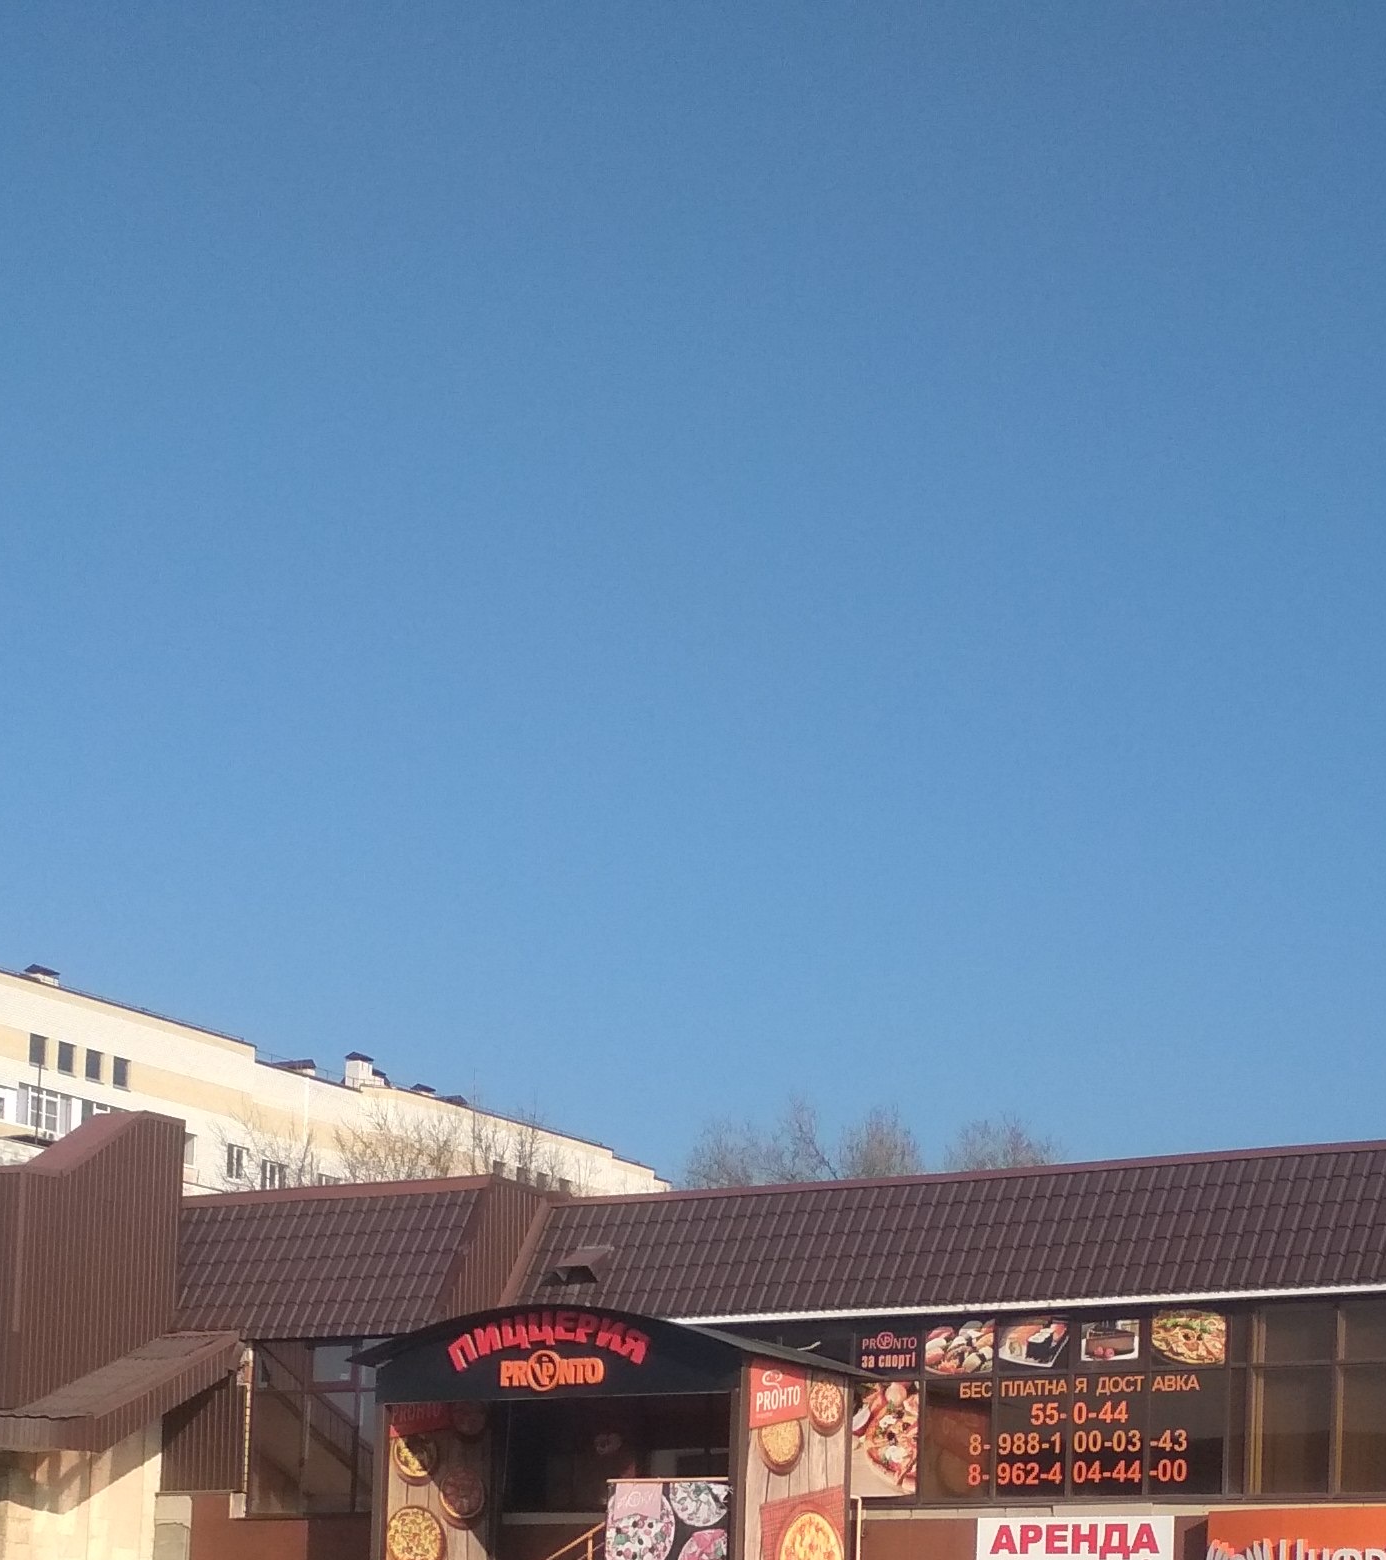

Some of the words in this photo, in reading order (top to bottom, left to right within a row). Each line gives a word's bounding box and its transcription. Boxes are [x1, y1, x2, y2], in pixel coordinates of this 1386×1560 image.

[447, 1310, 651, 1372] ПИЦЦЕРИЯ
[861, 1355, 875, 1368] за
[989, 1523, 1160, 1560] АРЕНДА
